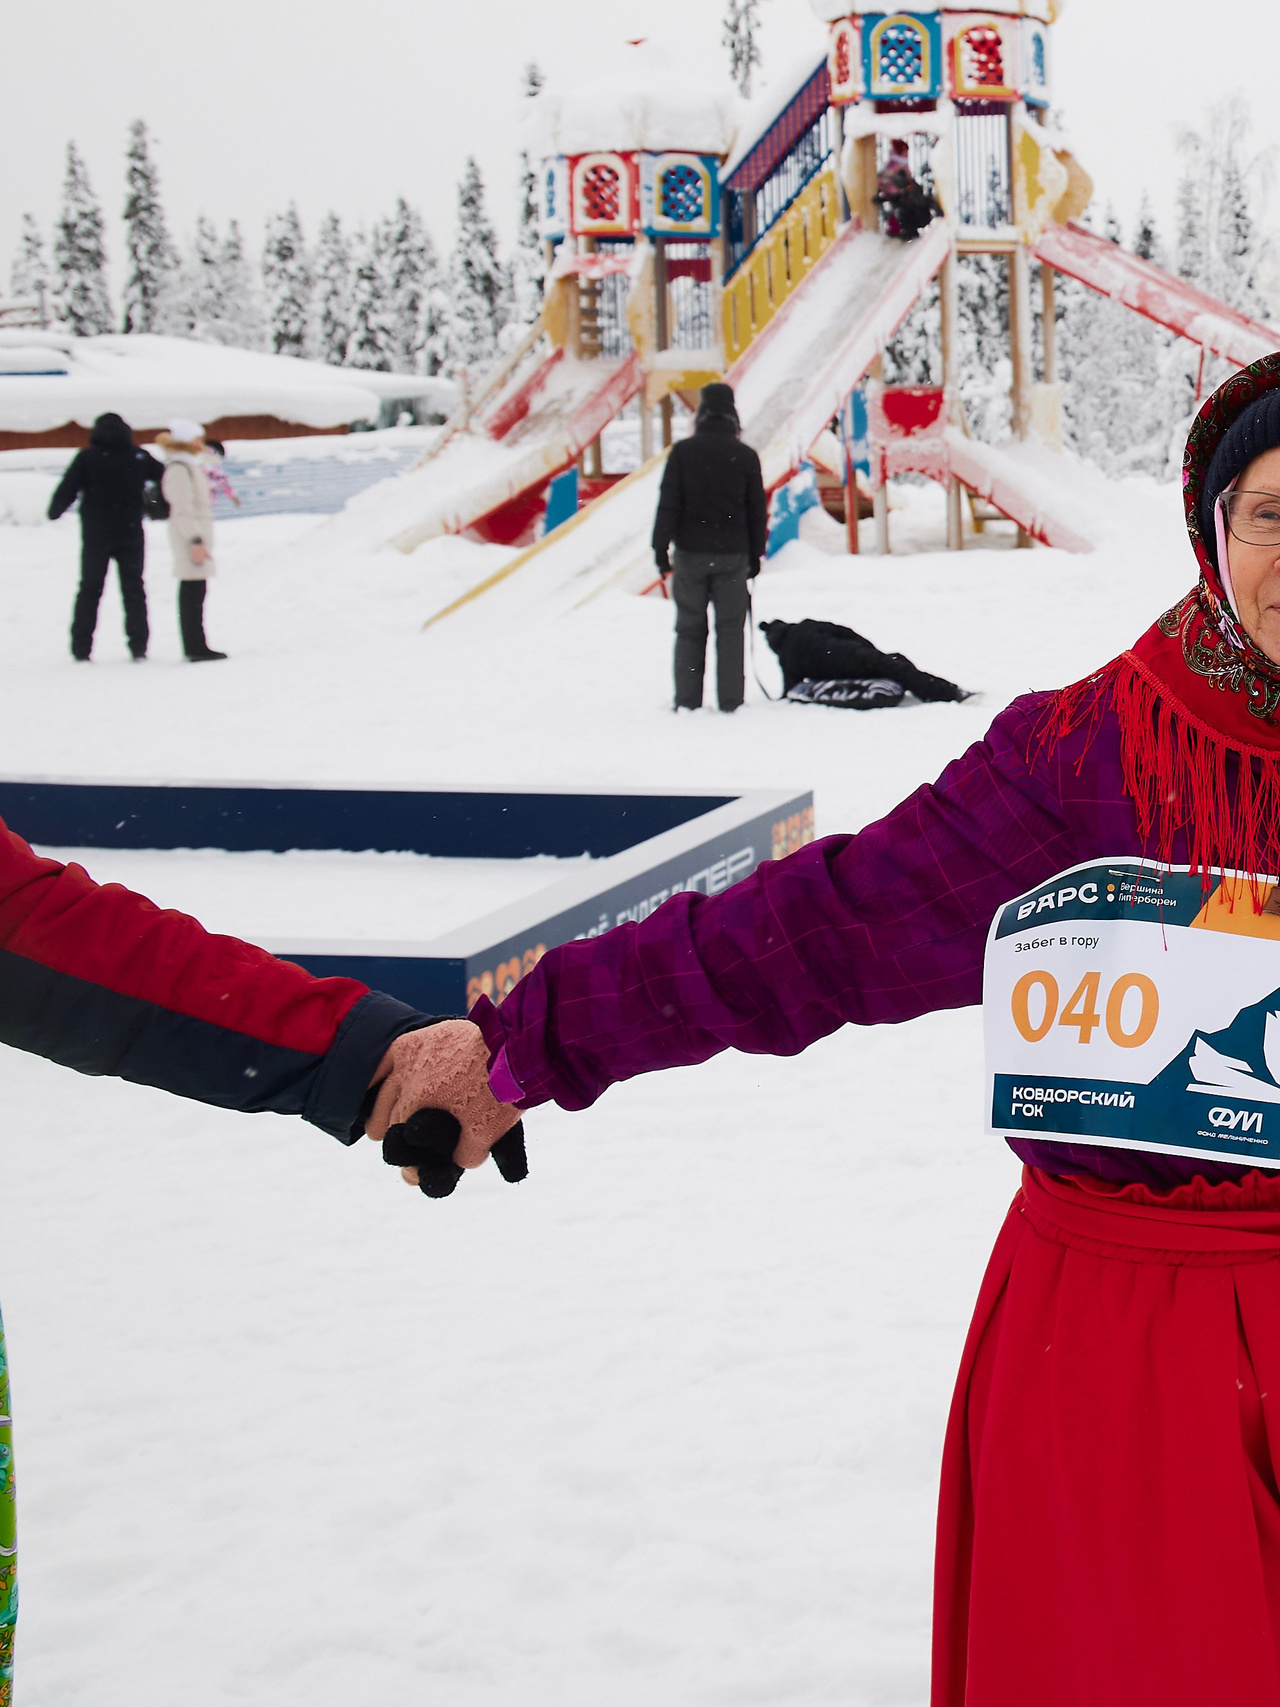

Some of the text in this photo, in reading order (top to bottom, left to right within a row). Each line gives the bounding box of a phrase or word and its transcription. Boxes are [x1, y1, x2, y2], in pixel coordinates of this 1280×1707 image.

[1120, 882, 1164, 895] Вершина
[1118, 892, 1178, 907] Гипербореи
[1014, 936, 1099, 953] Забег в гору
[1011, 970, 1160, 1048] 040
[1012, 1086, 1135, 1109] КОВДОРСКИЙ
[1011, 1102, 1044, 1118] ГОК
